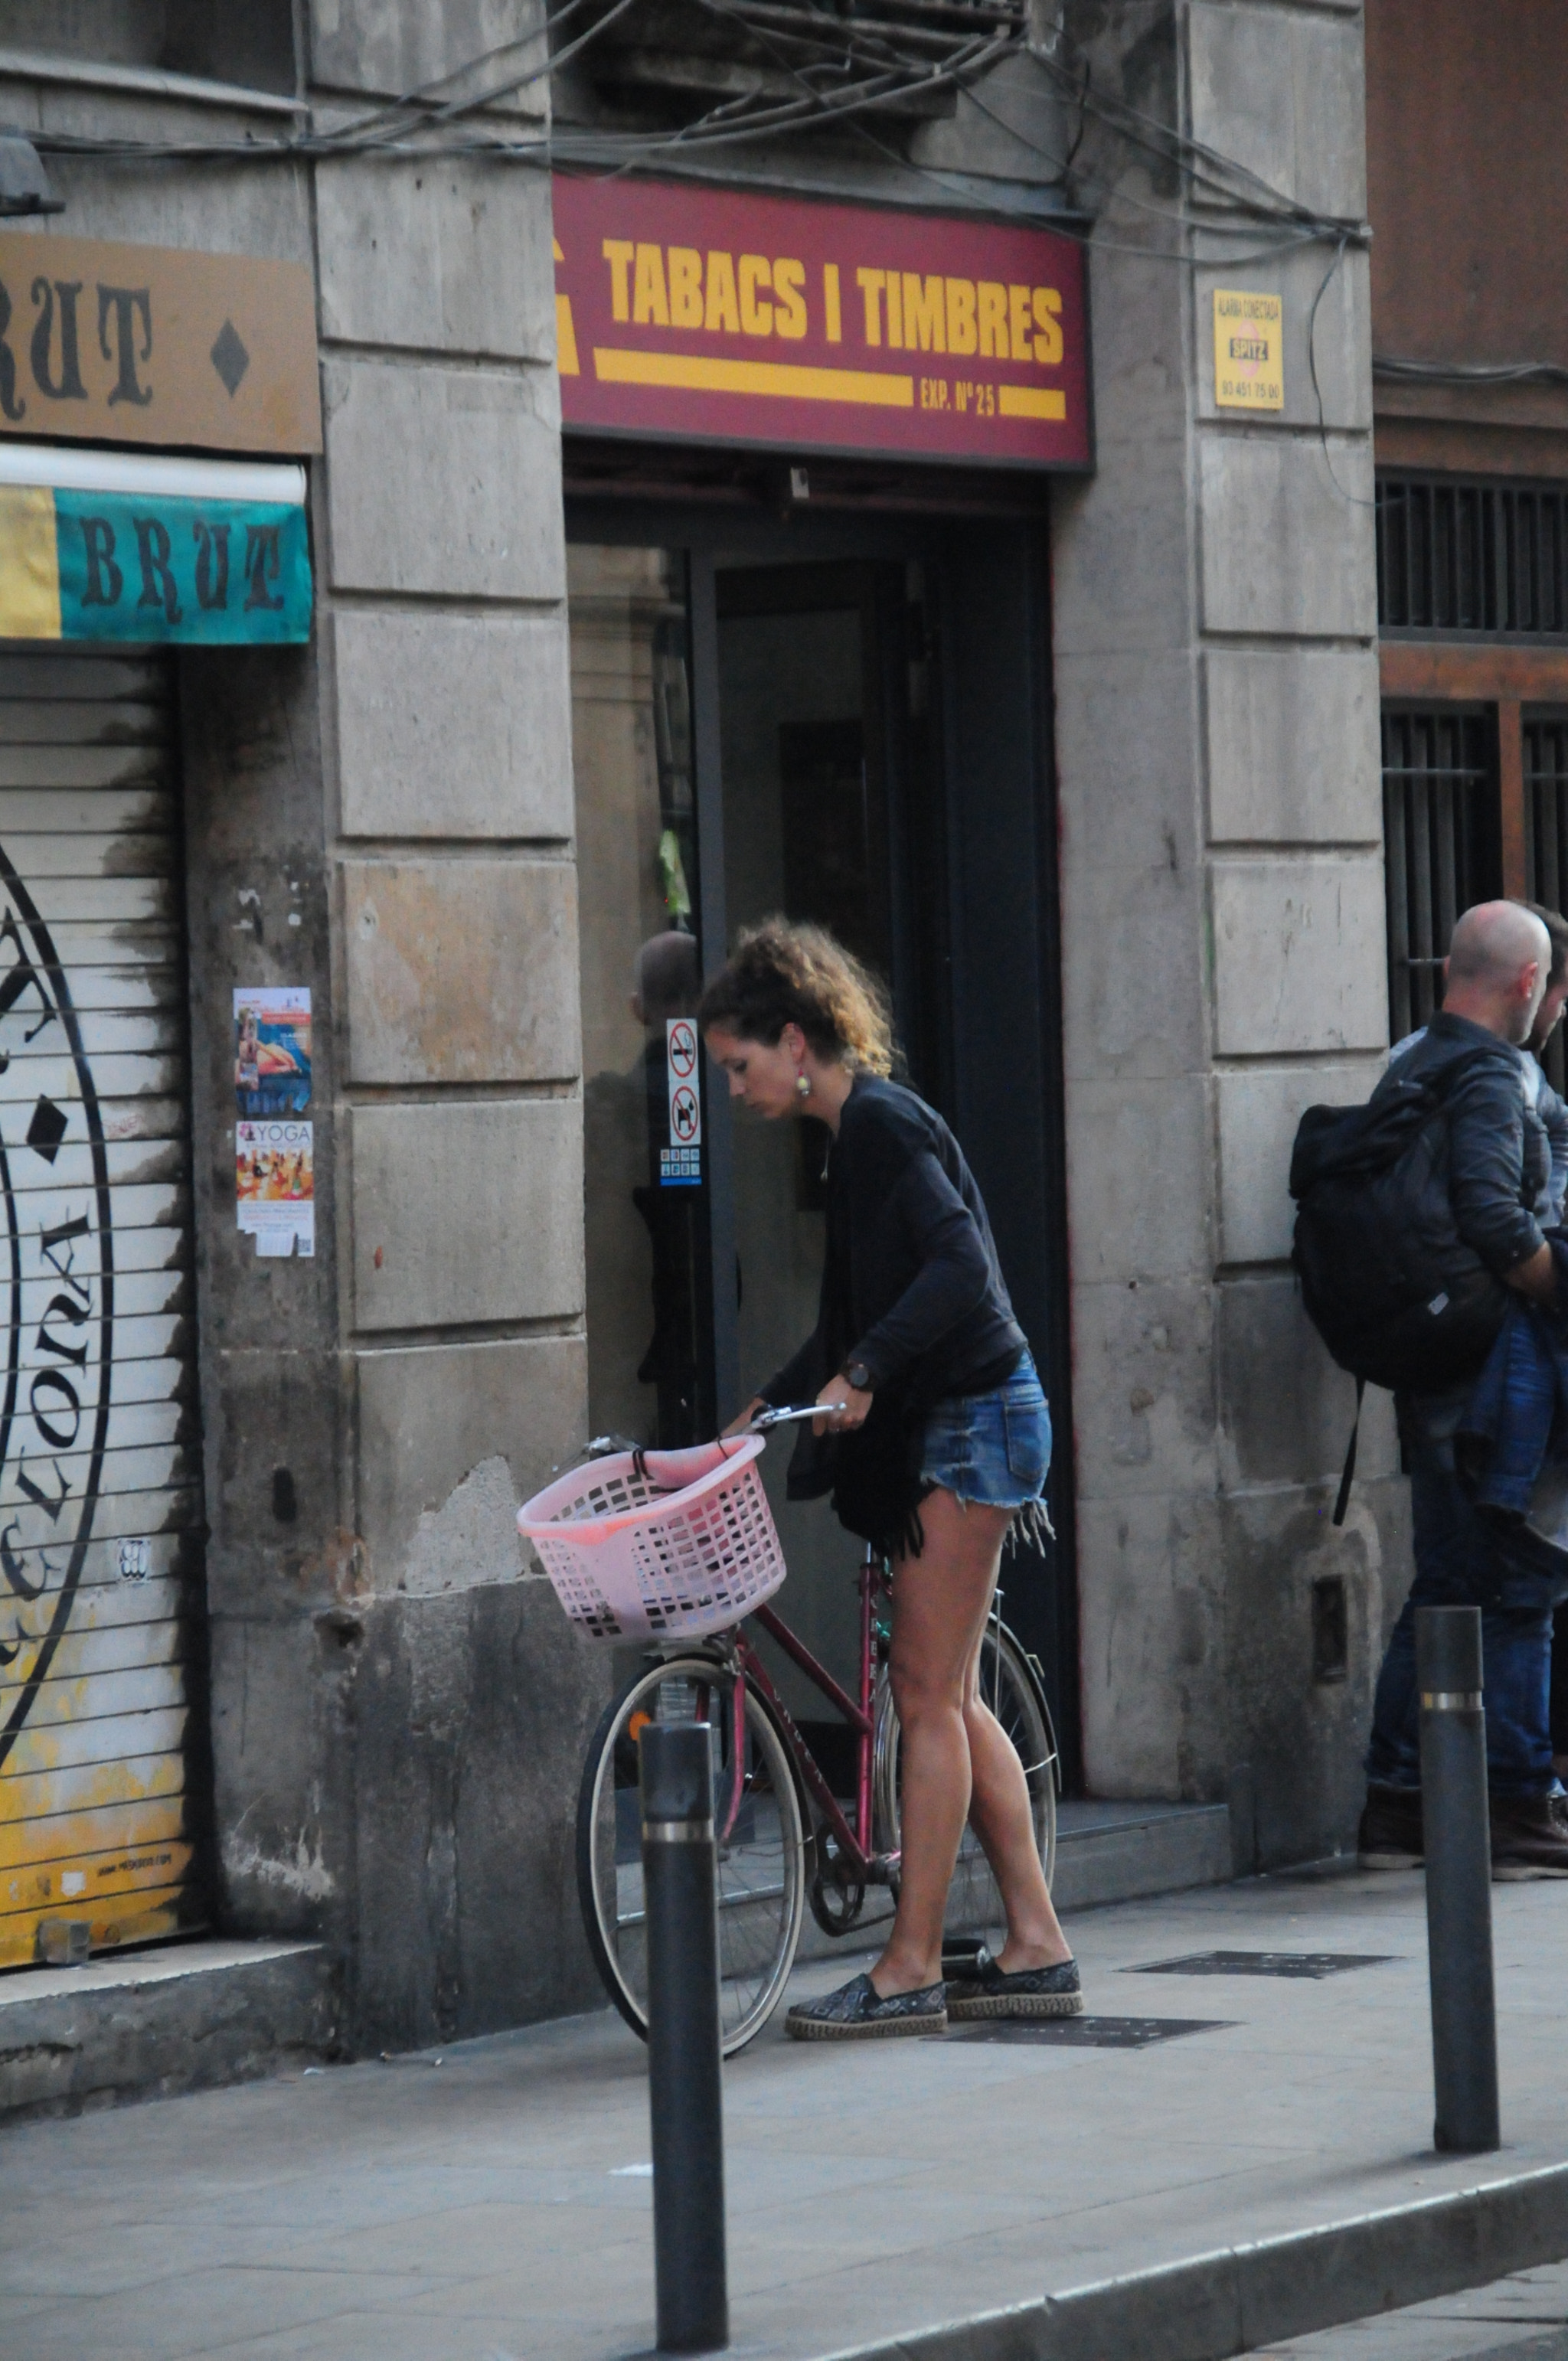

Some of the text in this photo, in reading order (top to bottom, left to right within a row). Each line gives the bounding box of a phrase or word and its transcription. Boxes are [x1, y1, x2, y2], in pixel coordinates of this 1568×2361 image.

[602, 238, 1063, 364] TABACS I TIMBRES
[1232, 339, 1266, 360] SPITZ
[921, 377, 951, 410] EXP.
[80, 517, 285, 625] BRUT
[257, 1125, 310, 1141] YOGA
